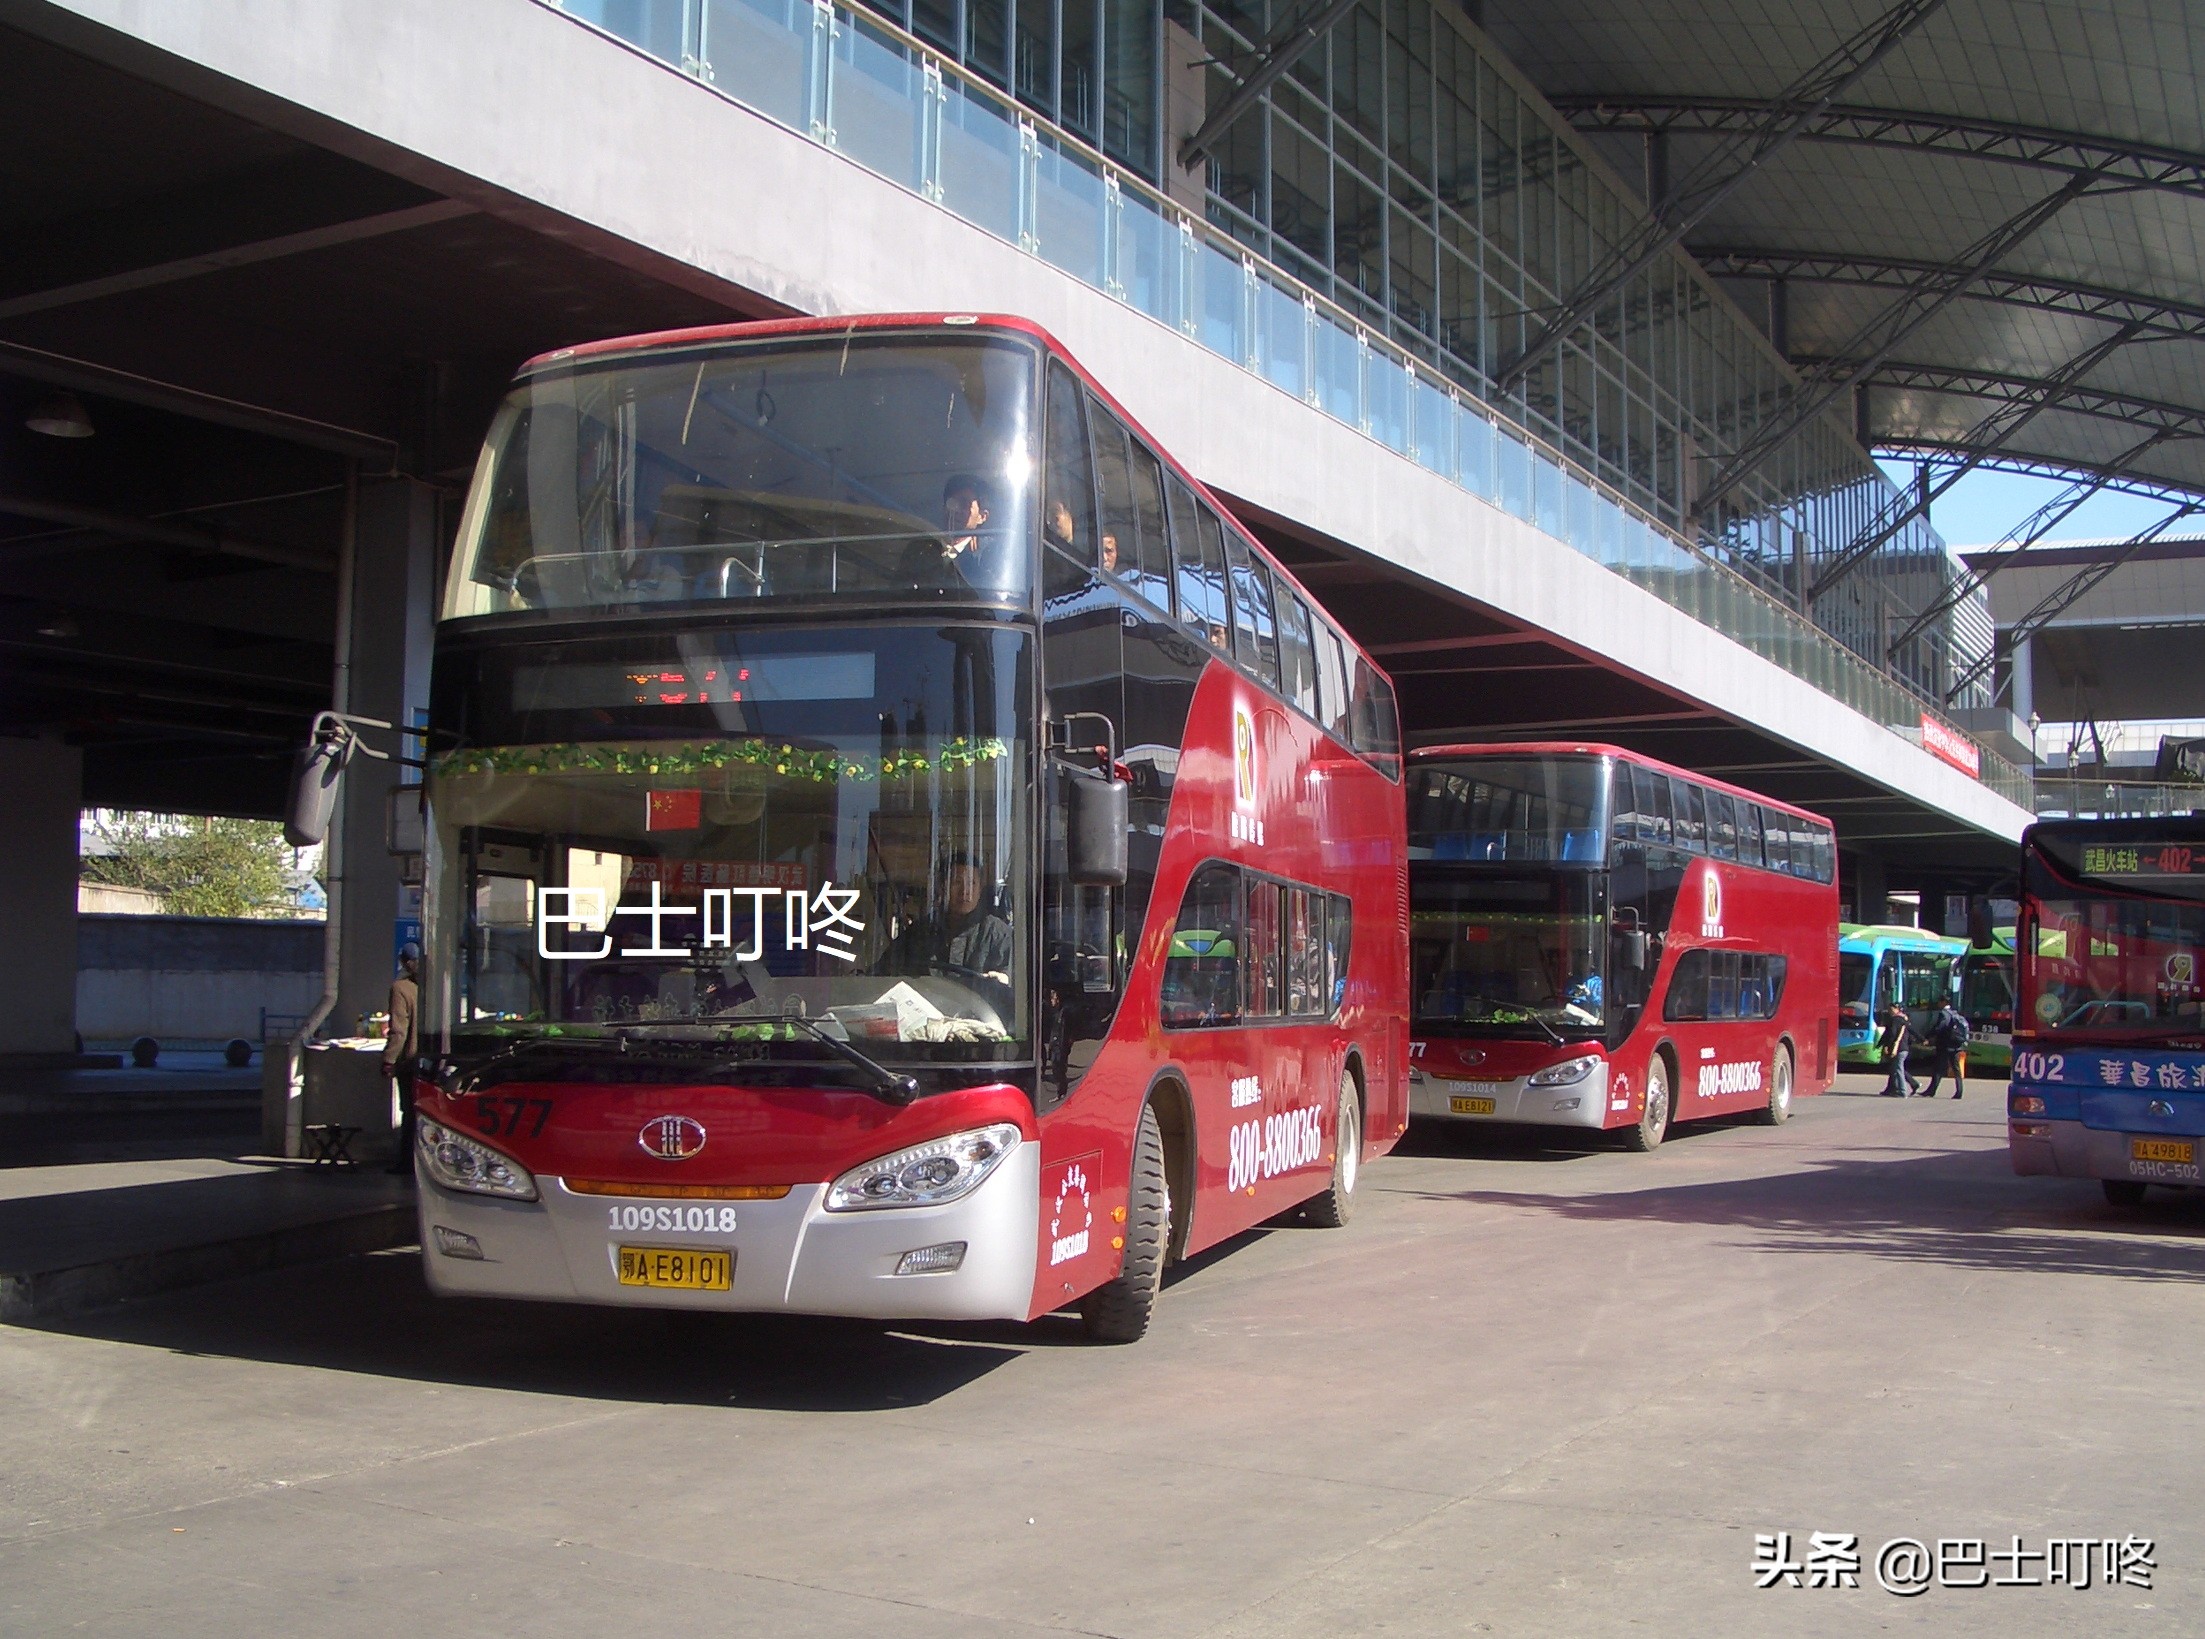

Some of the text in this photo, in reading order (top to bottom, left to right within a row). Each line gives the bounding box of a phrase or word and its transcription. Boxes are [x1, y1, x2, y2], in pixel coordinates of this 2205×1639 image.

[2085, 848, 2192, 873] 武昌火车站 402
[1699, 1060, 1762, 1097] 800-8800366
[2014, 1052, 2064, 1082] 402
[479, 1096, 554, 1137] 577
[1228, 1103, 1322, 1193] 800-8800366
[2129, 1160, 2200, 1180] 05HC-502
[608, 1206, 737, 1233] 109S1018
